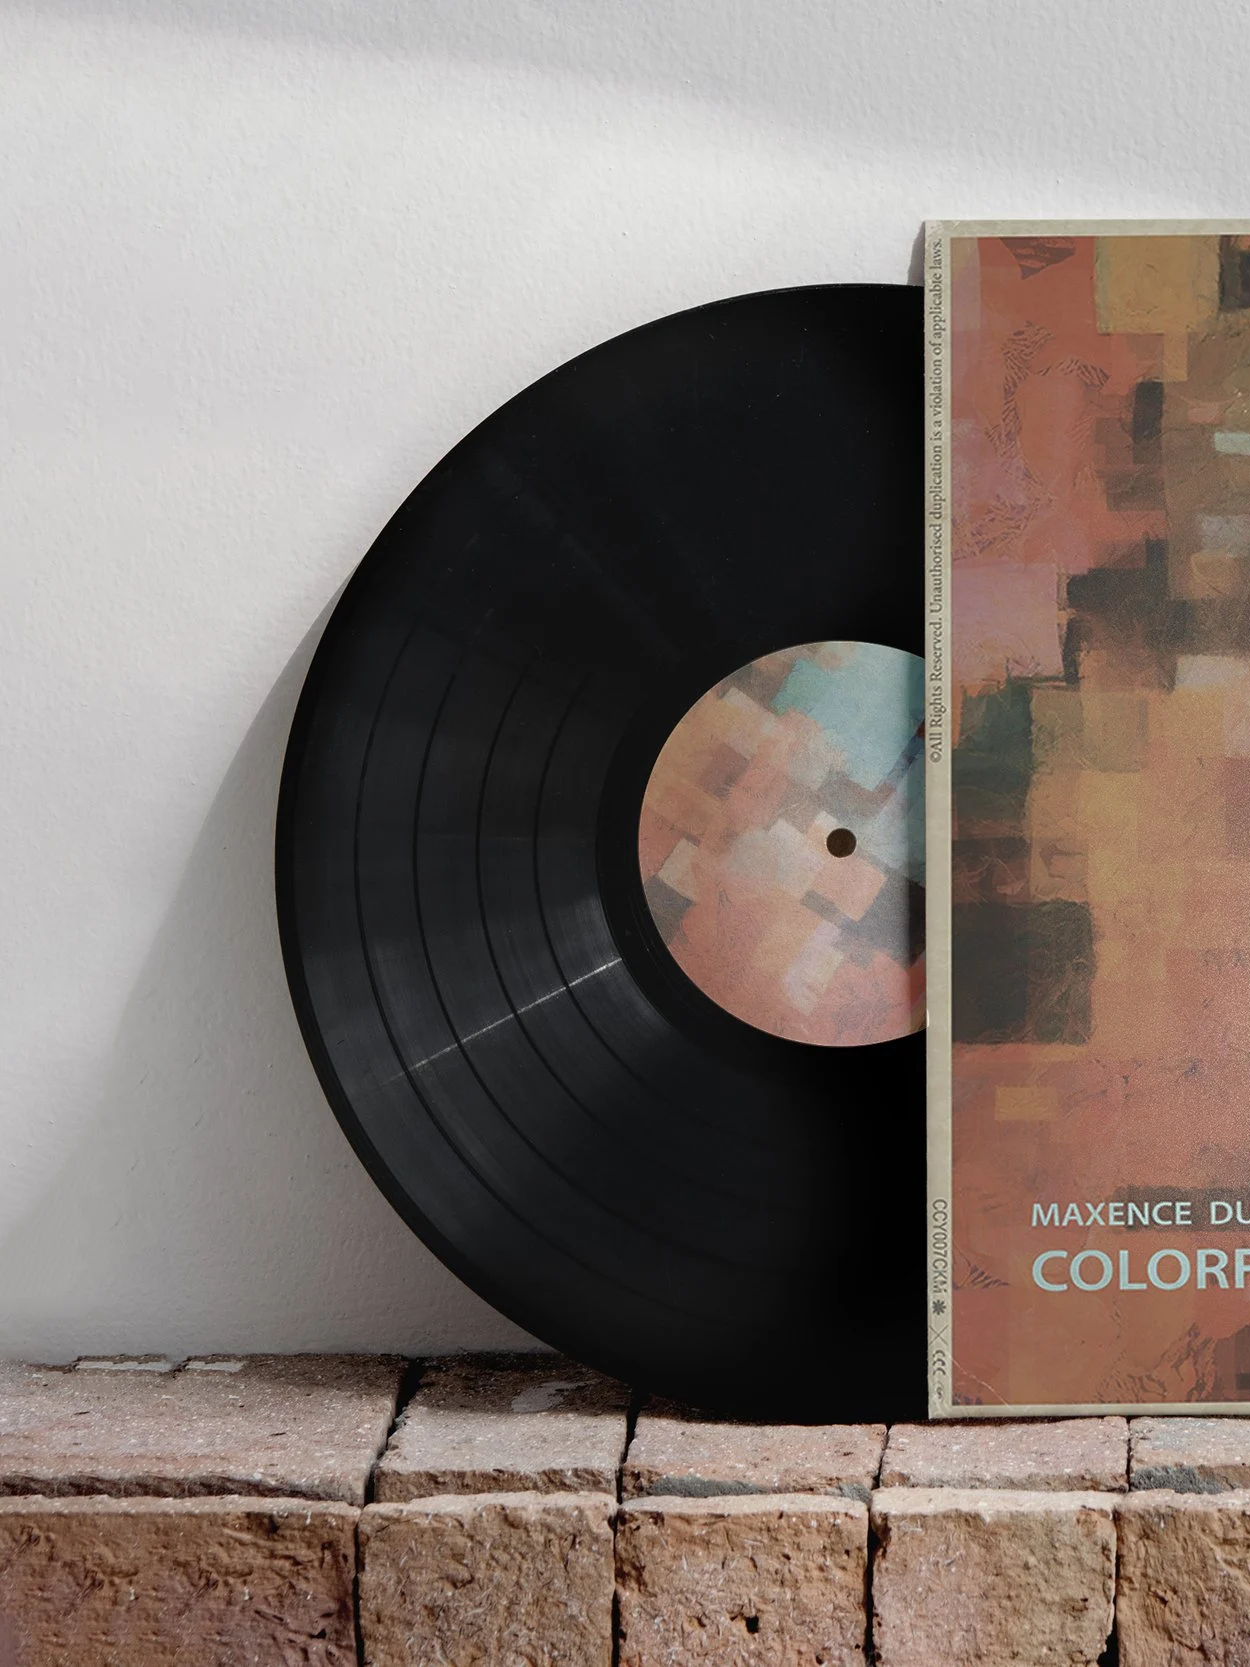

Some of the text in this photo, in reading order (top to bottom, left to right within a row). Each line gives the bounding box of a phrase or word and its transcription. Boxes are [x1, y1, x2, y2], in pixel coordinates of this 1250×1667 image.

[928, 239, 942, 269] laws.
[928, 273, 947, 339] applicable
[928, 359, 942, 416] violation
[928, 445, 947, 519] duplication
[929, 523, 943, 614] Unauthorised
[929, 618, 943, 682] Reserved.
[929, 686, 947, 728] Rights
[1031, 1201, 1192, 1227] MAXENCE
